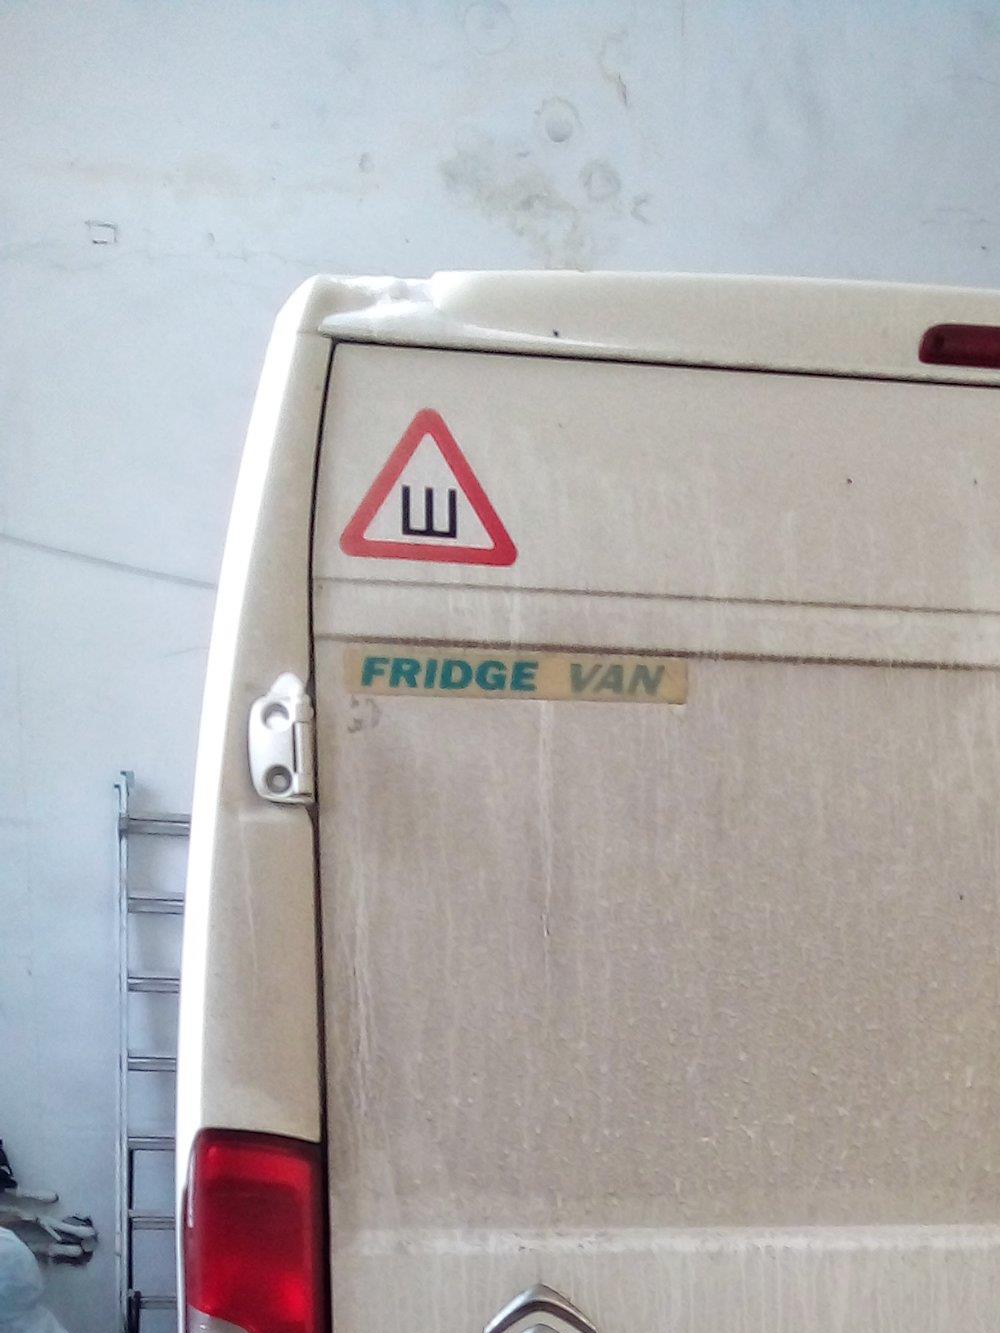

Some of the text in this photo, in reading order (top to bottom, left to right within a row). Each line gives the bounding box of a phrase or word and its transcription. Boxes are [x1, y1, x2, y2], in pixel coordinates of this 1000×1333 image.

[401, 484, 458, 539] Ш
[360, 656, 666, 697] FRIDGE VAN
